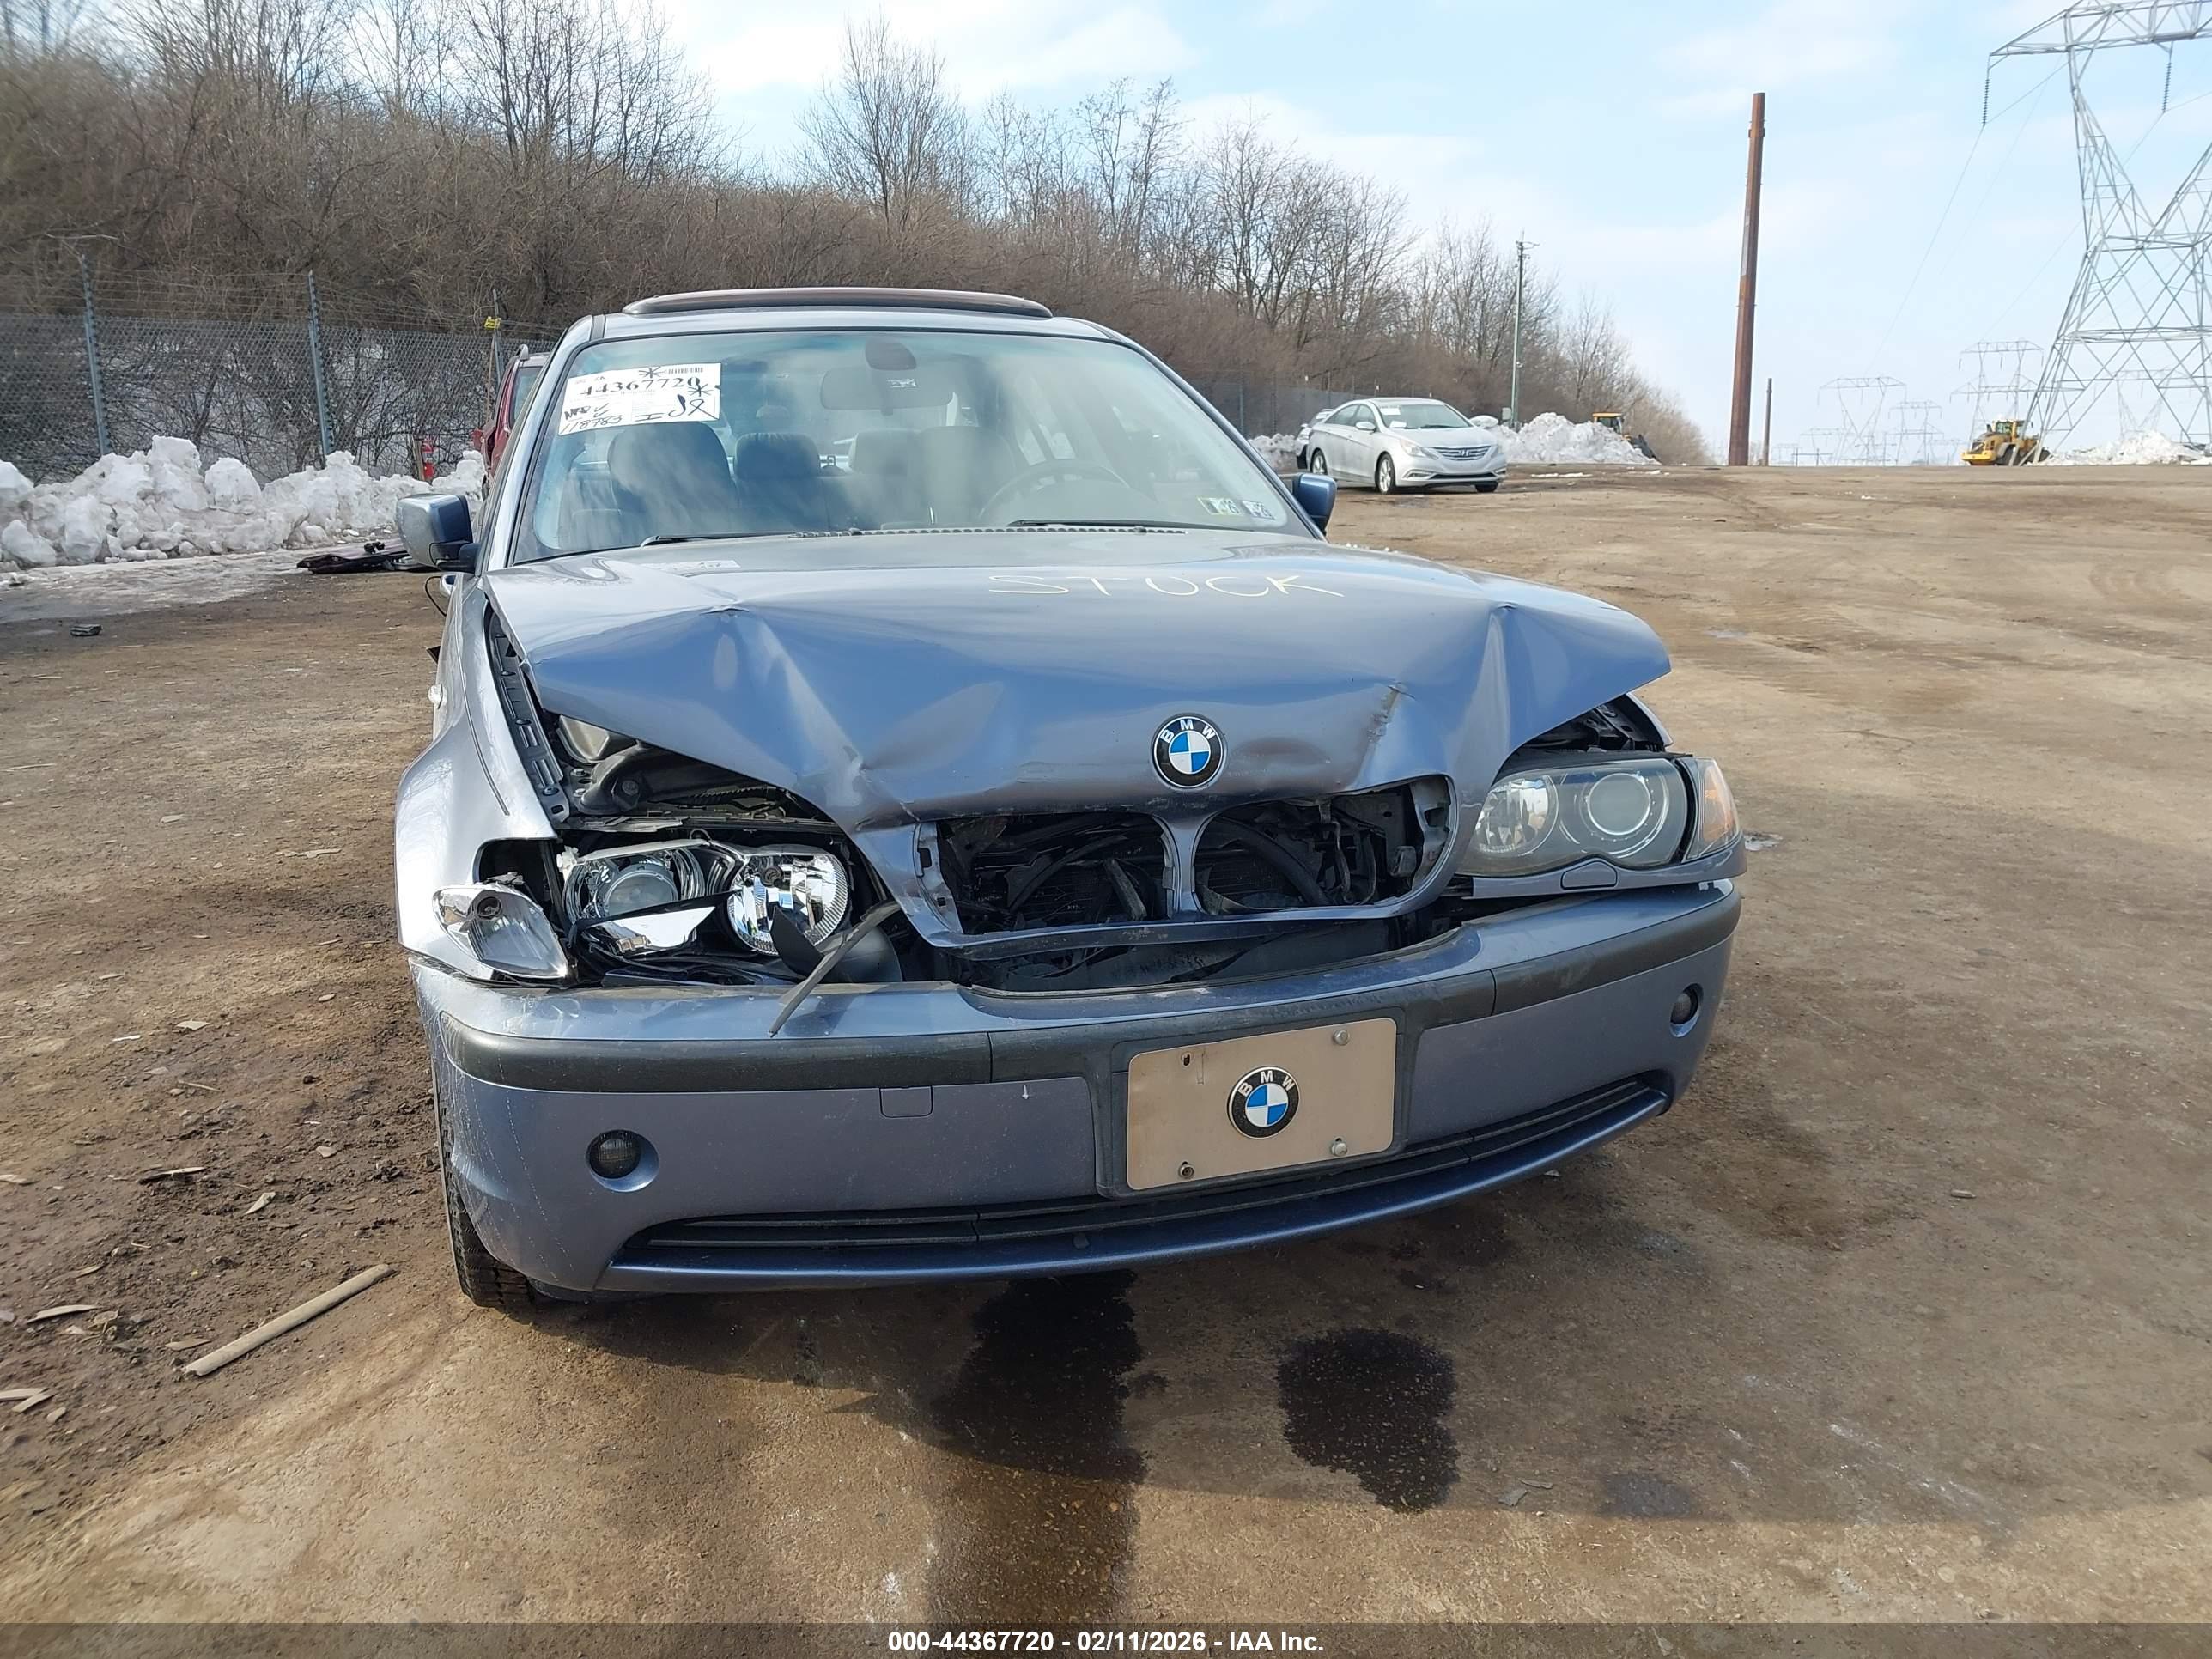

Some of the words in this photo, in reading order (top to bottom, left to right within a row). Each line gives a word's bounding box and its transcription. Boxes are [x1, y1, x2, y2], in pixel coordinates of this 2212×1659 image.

[988, 575, 1345, 598] STUCK
[1159, 719, 1216, 744] BMW
[1237, 1070, 1295, 1097] BMW
